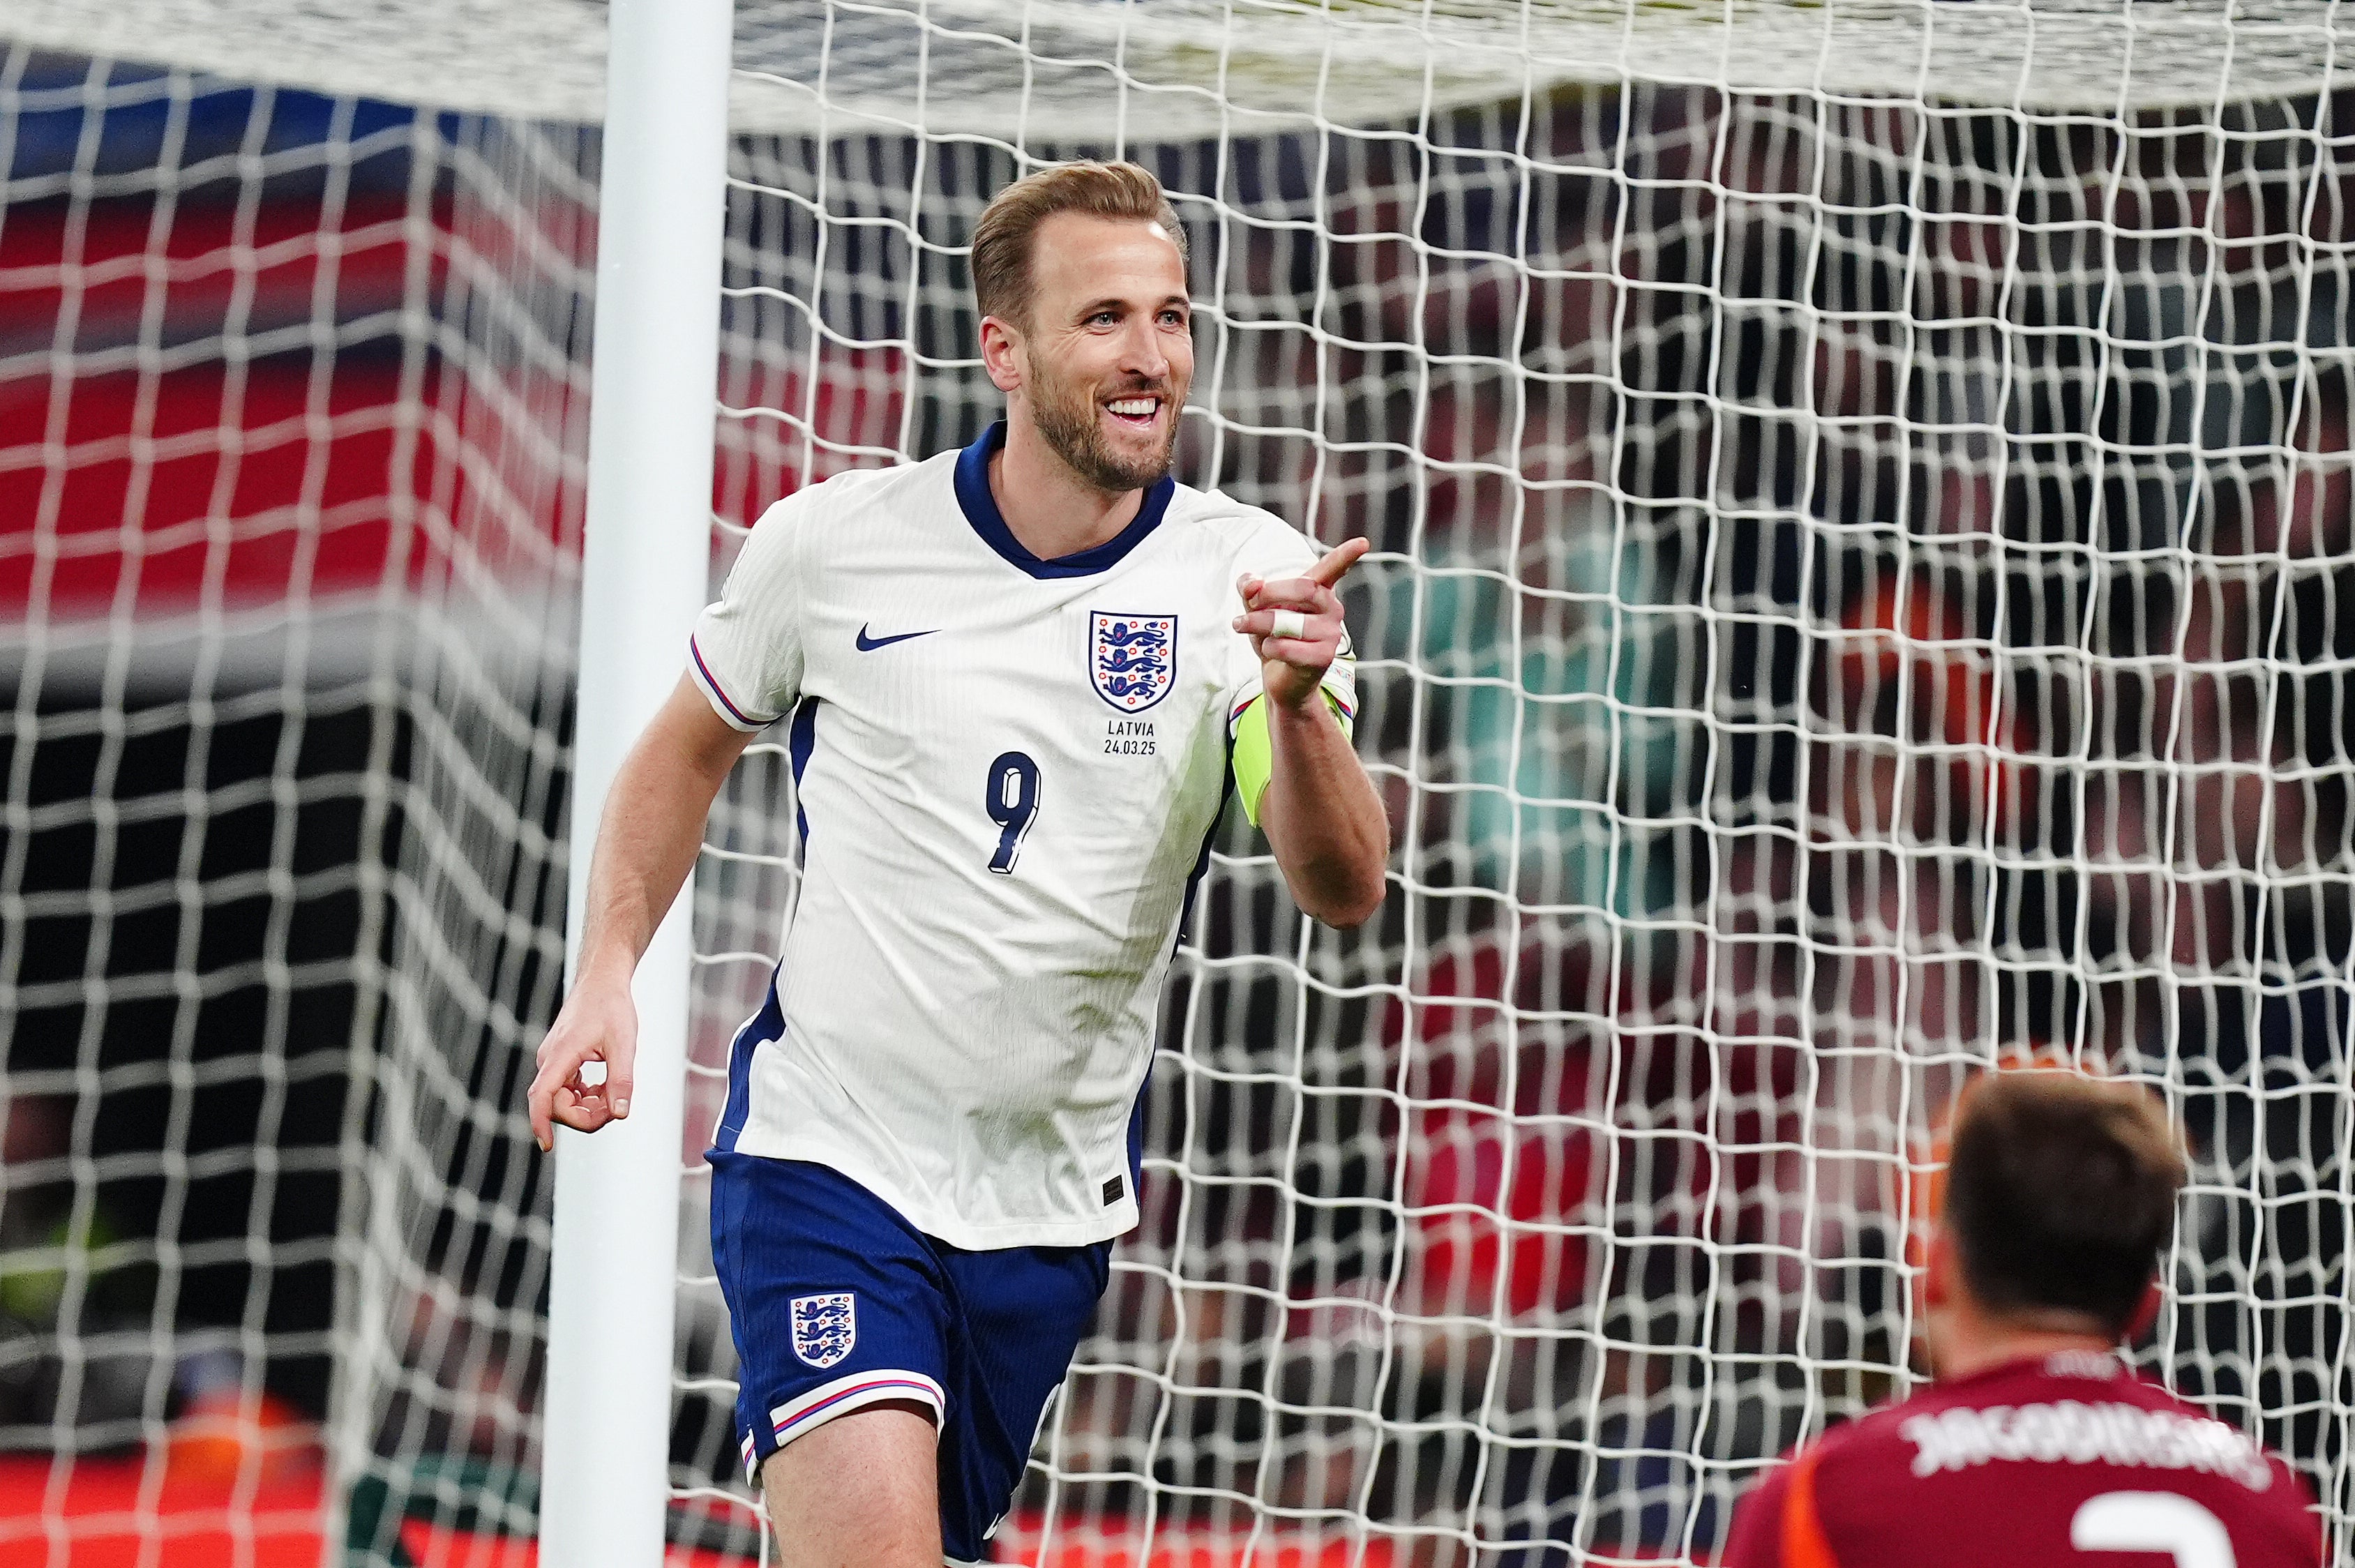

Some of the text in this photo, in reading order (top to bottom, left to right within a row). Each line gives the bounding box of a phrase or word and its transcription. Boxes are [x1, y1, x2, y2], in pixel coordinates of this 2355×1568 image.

[1108, 721, 1154, 737] LATVIA
[1104, 739, 1156, 755] 24.03.25
[986, 751, 1041, 875] 9
